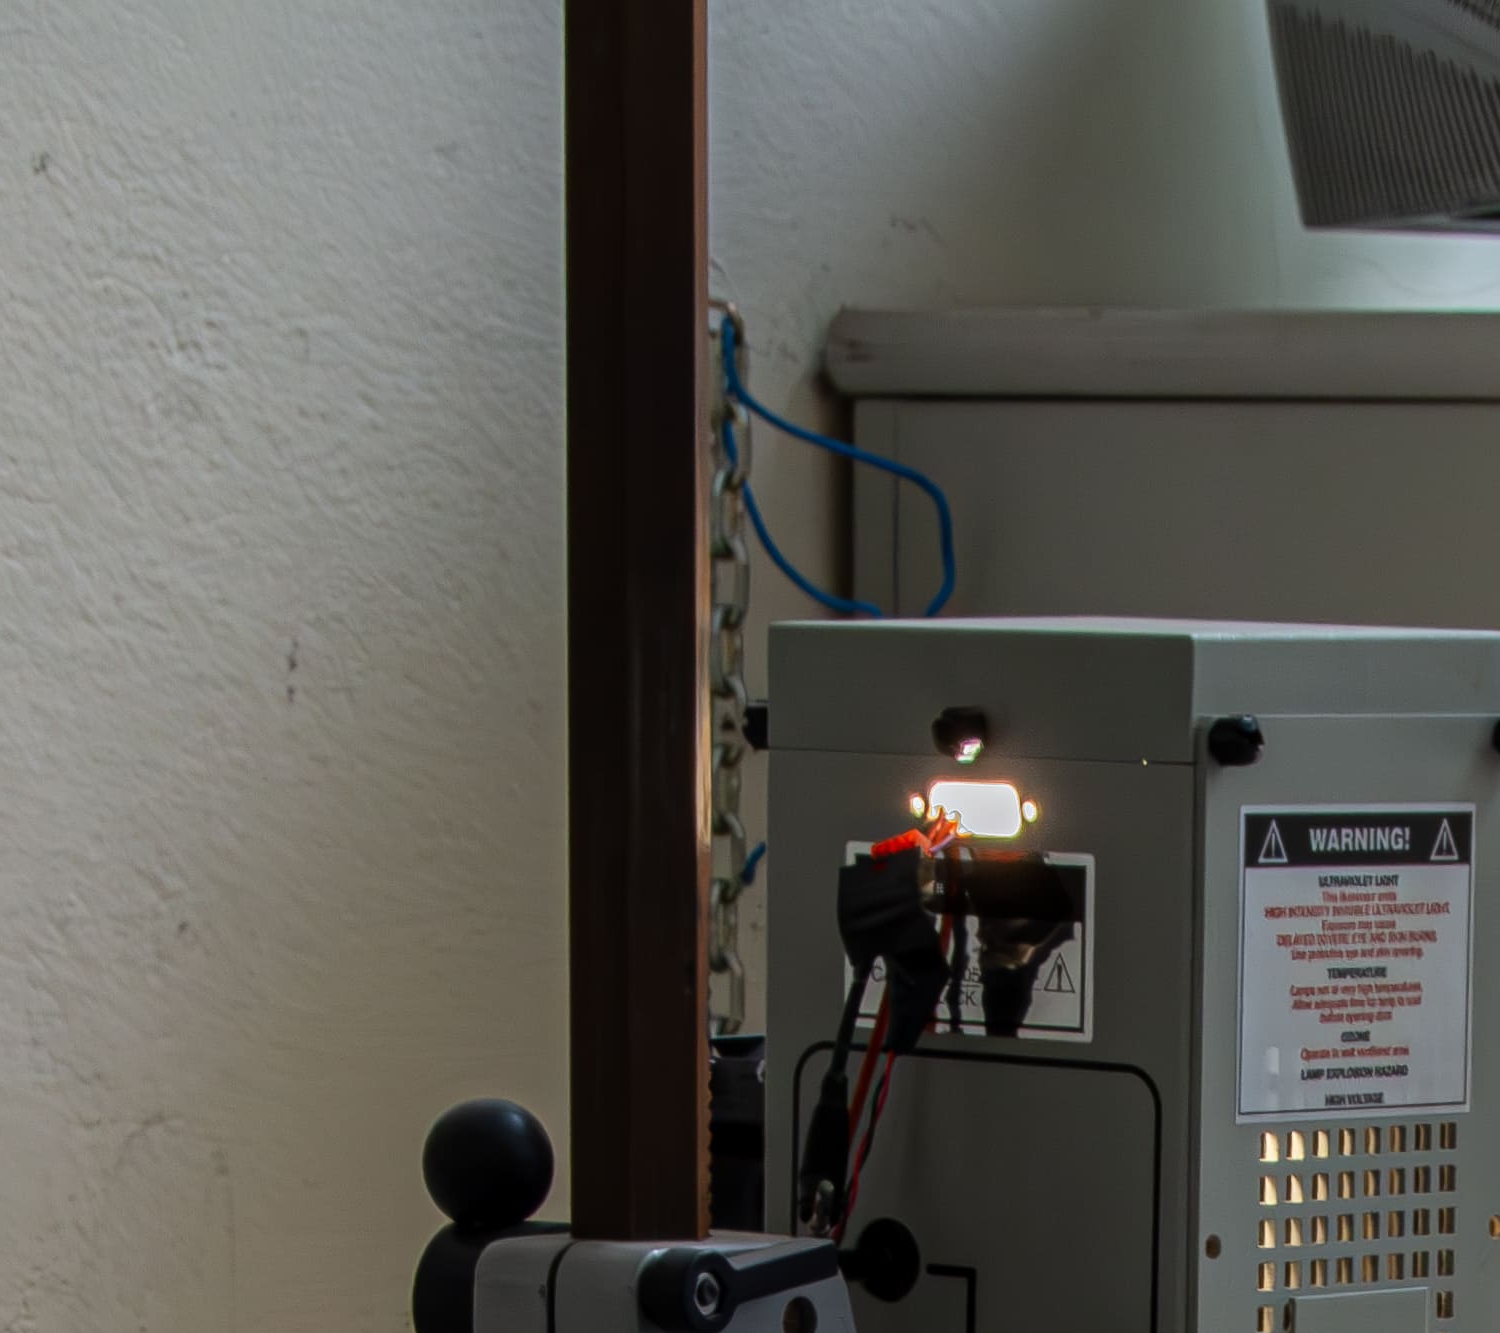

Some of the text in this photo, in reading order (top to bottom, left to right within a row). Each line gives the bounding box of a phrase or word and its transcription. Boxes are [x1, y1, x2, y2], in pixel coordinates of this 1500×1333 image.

[1309, 827, 1411, 851] WARNING!
[1326, 967, 1387, 979] TEMPERATURE
[1301, 1068, 1325, 1081] LAMP
